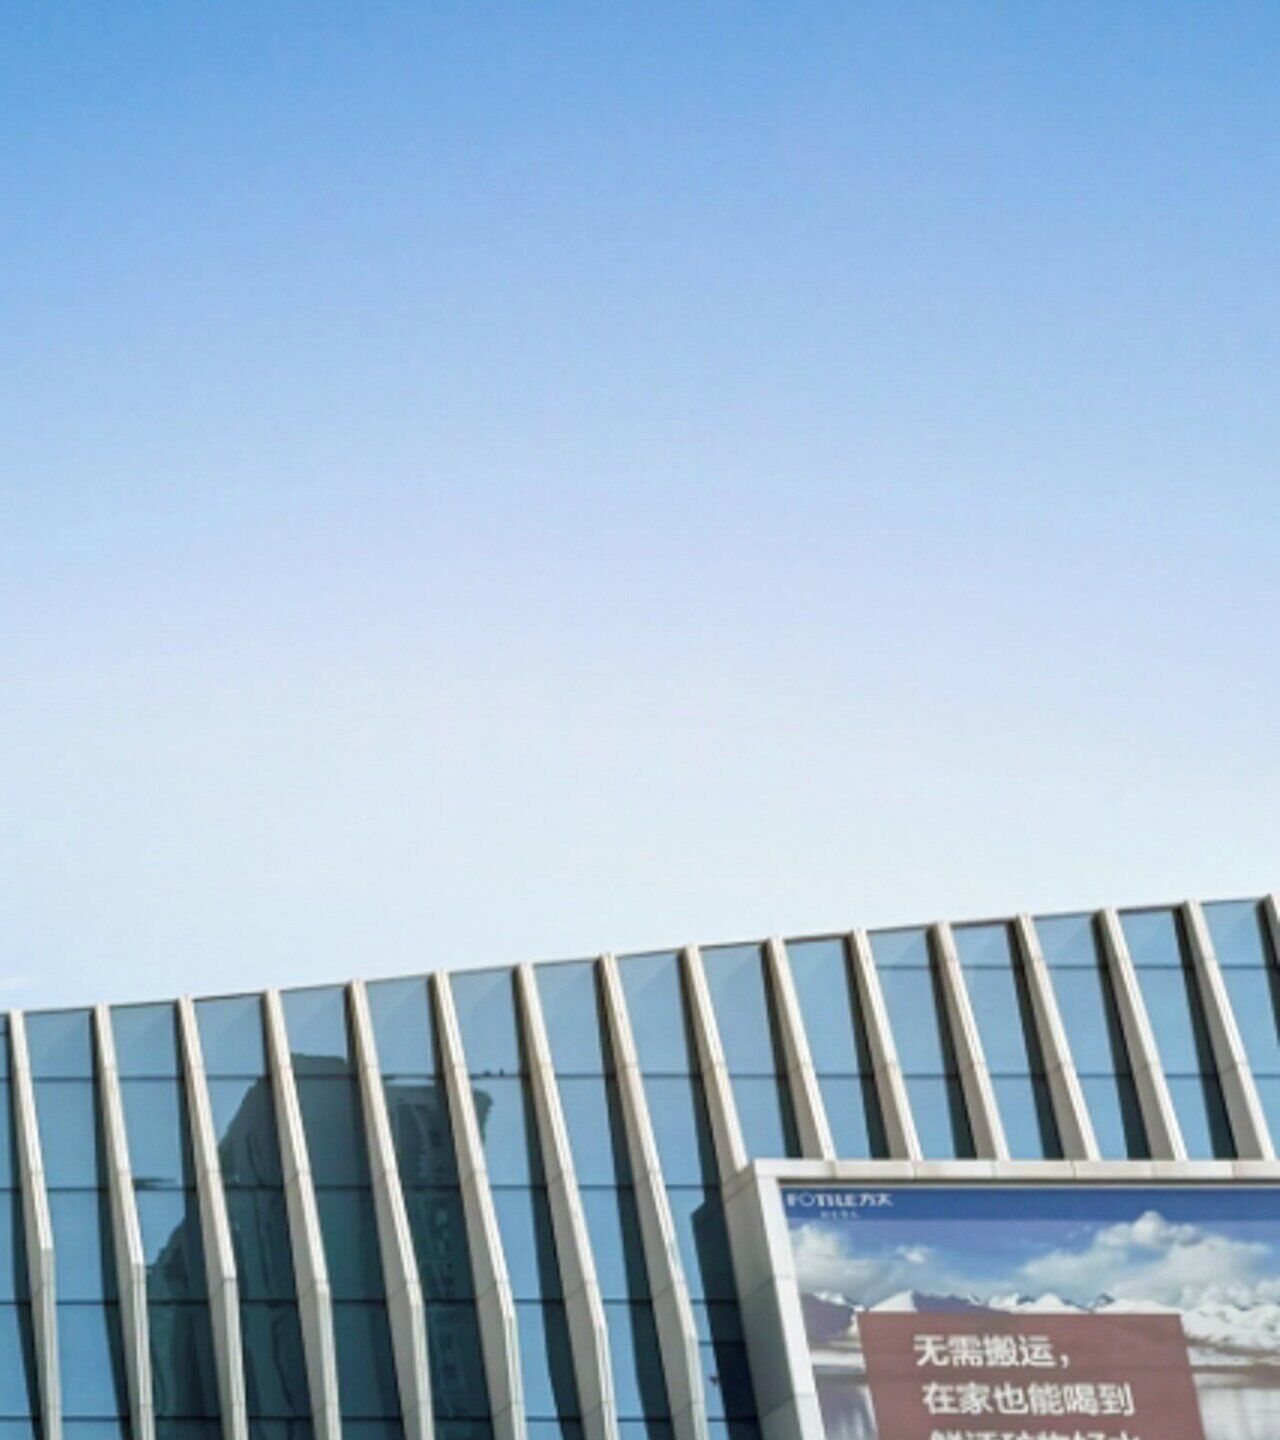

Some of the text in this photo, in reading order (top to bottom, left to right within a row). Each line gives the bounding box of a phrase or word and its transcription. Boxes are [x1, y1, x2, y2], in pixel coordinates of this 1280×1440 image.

[922, 1381, 1136, 1417] 在家也能喝到
